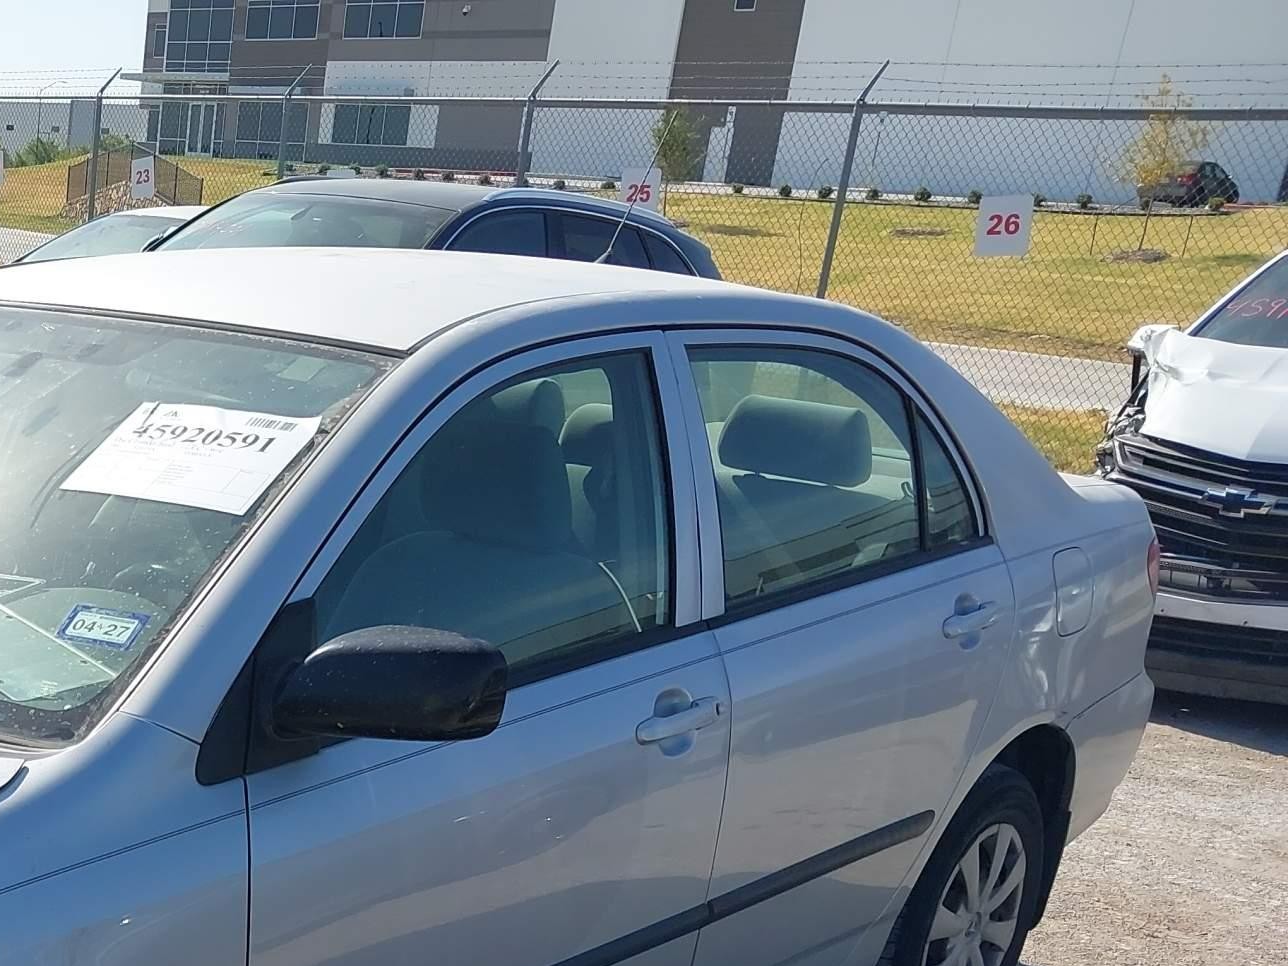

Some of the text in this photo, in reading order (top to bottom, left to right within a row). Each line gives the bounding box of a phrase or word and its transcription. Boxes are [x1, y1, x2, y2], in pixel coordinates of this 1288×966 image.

[135, 169, 150, 185] 23
[626, 183, 651, 203] 25
[986, 213, 1020, 236] 26
[132, 422, 277, 453] 45920591
[72, 619, 98, 633] 04
[102, 623, 131, 638] 27
